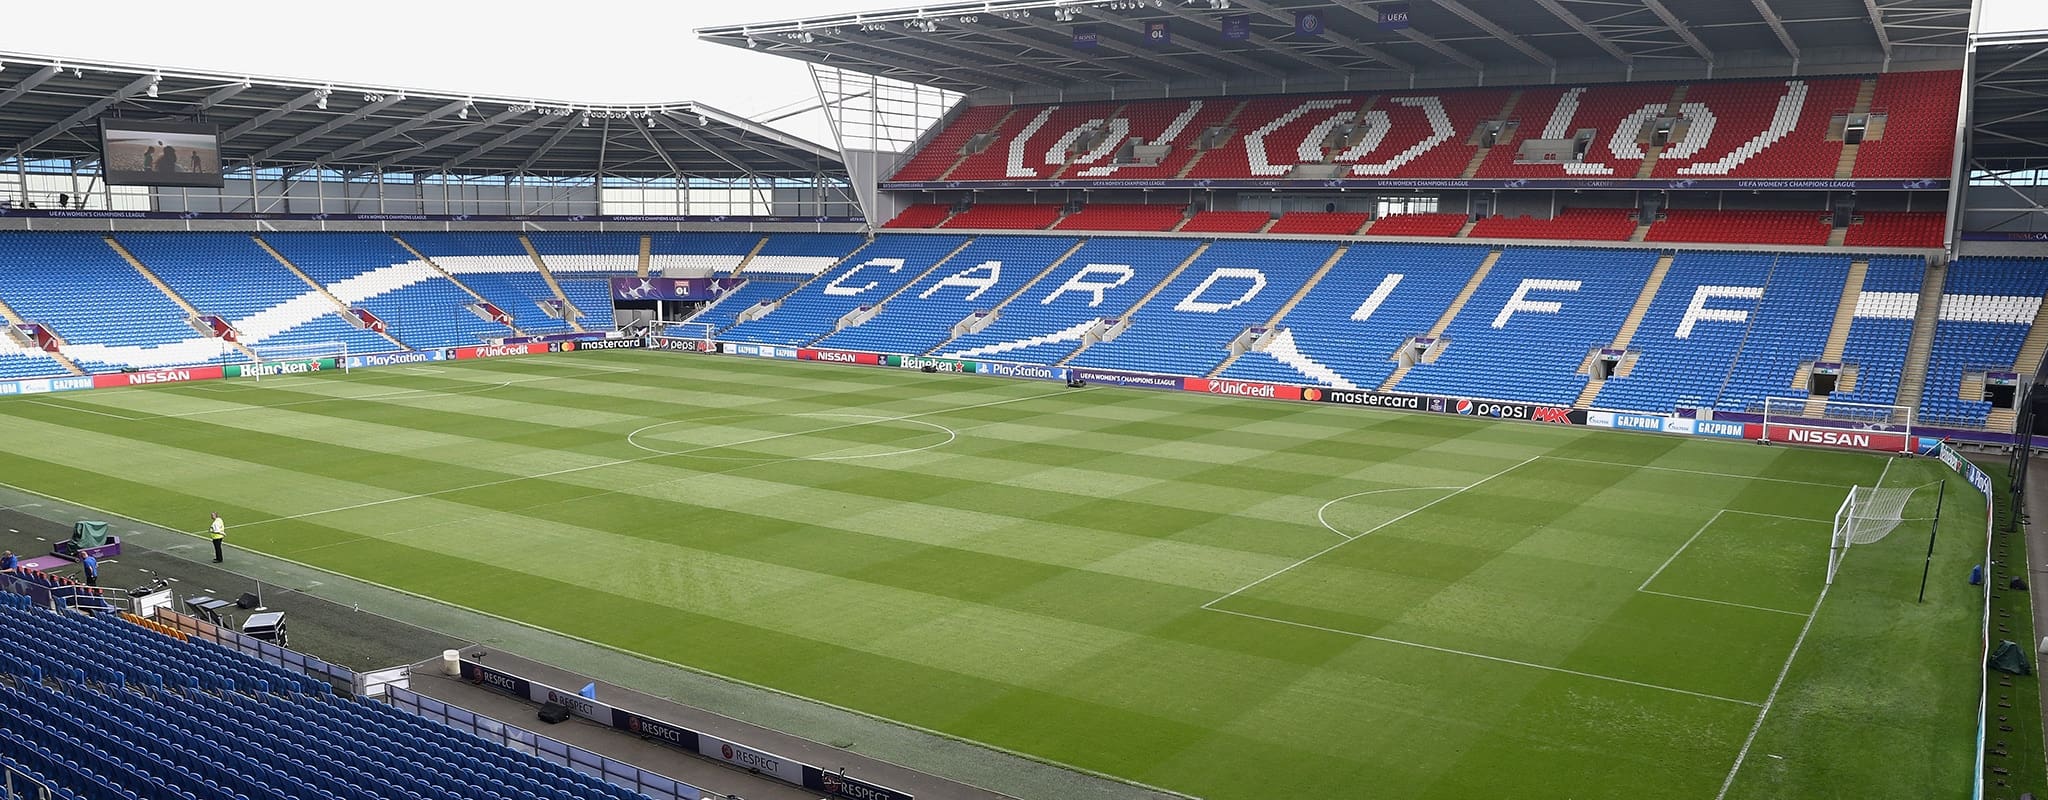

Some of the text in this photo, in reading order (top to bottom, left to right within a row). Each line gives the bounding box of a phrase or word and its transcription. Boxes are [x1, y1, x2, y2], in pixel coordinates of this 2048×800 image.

[1387, 13, 1408, 21] UEFA
[1151, 30, 1164, 39] OL
[675, 287, 689, 295] OL
[486, 345, 528, 357] UniCredit
[581, 338, 640, 350] mastercard
[670, 340, 695, 351] pepsi
[366, 353, 426, 366] PlayStation
[817, 351, 856, 363] NISSAN
[900, 356, 953, 371] Heineken
[129, 370, 190, 384] NISSAN
[993, 364, 1052, 379] PlayStation
[53, 378, 92, 390] GAZPROM
[1095, 373, 1120, 381] WOMEN'S
[1121, 375, 1154, 384] CHAMPIONS
[1154, 378, 1176, 386] LEAGUE
[1220, 381, 1275, 397] UniCredit
[1331, 390, 1418, 409] mastercard
[1477, 403, 1574, 424] pepsi MAX
[1618, 415, 1659, 429] GAZPROM
[1698, 422, 1742, 436] GAZPROM
[1788, 429, 1870, 447] NISSAN
[484, 671, 515, 690] RESPECT
[559, 695, 594, 716] RESPECT
[642, 723, 681, 743] RESPECT
[735, 750, 780, 773] RESPECT
[841, 782, 890, 800] RESPECT
